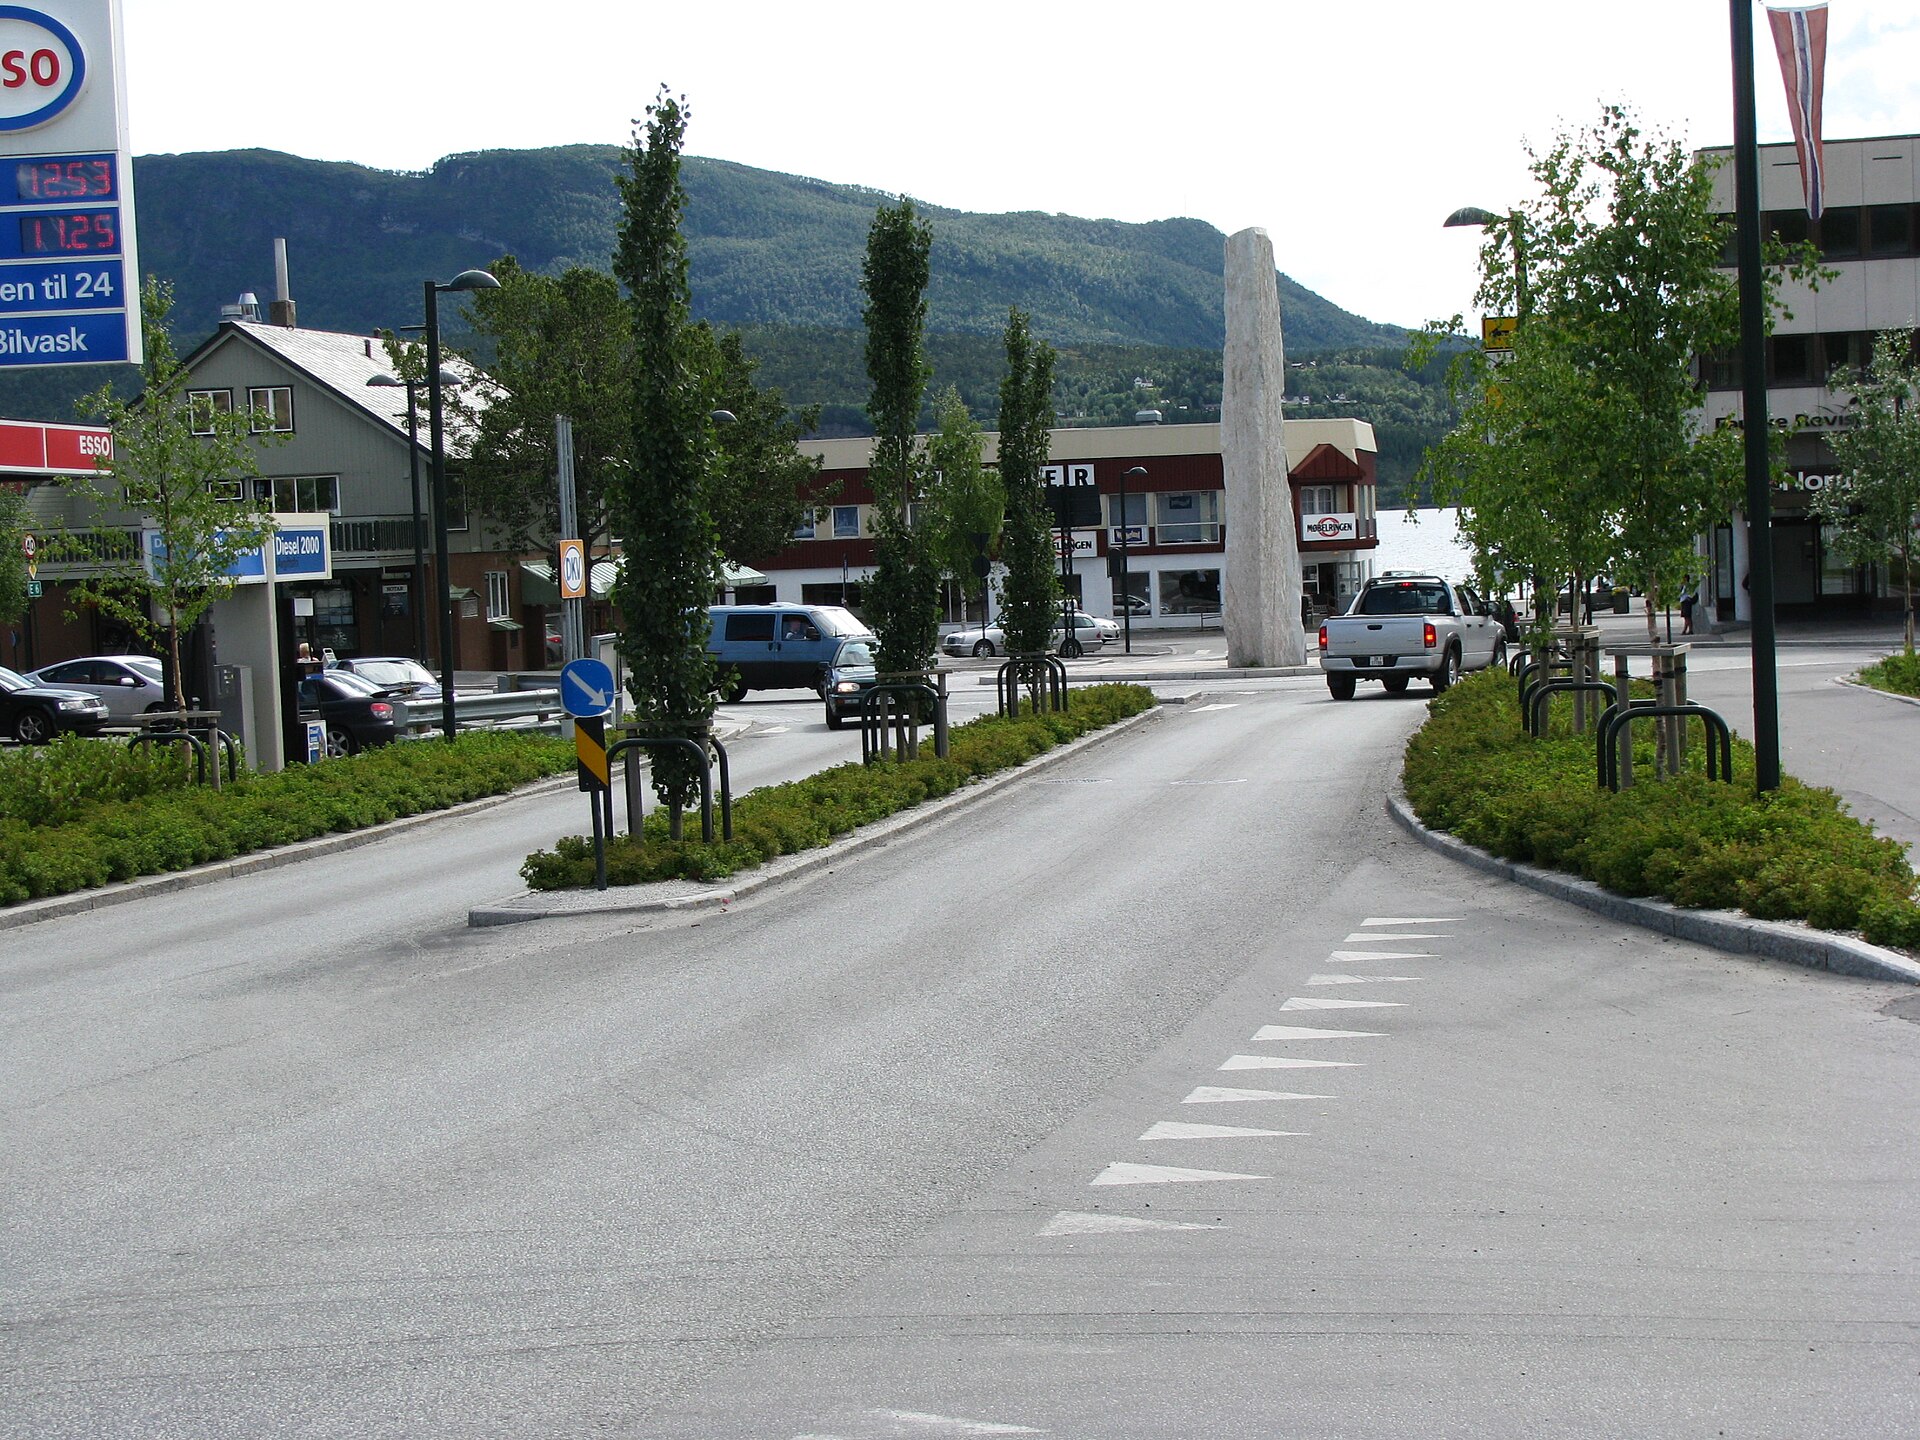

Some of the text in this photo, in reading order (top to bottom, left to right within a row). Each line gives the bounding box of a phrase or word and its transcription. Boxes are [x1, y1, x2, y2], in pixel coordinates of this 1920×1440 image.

[31, 161, 111, 196] 12.53
[35, 214, 114, 250] 11.25
[41, 273, 68, 300] til
[75, 271, 114, 298] 24
[79, 435, 110, 456] ESSO
[276, 536, 300, 556] Diesel
[301, 535, 320, 555] 2000
[566, 557, 581, 581] DKV
[30, 584, 34, 594] E
